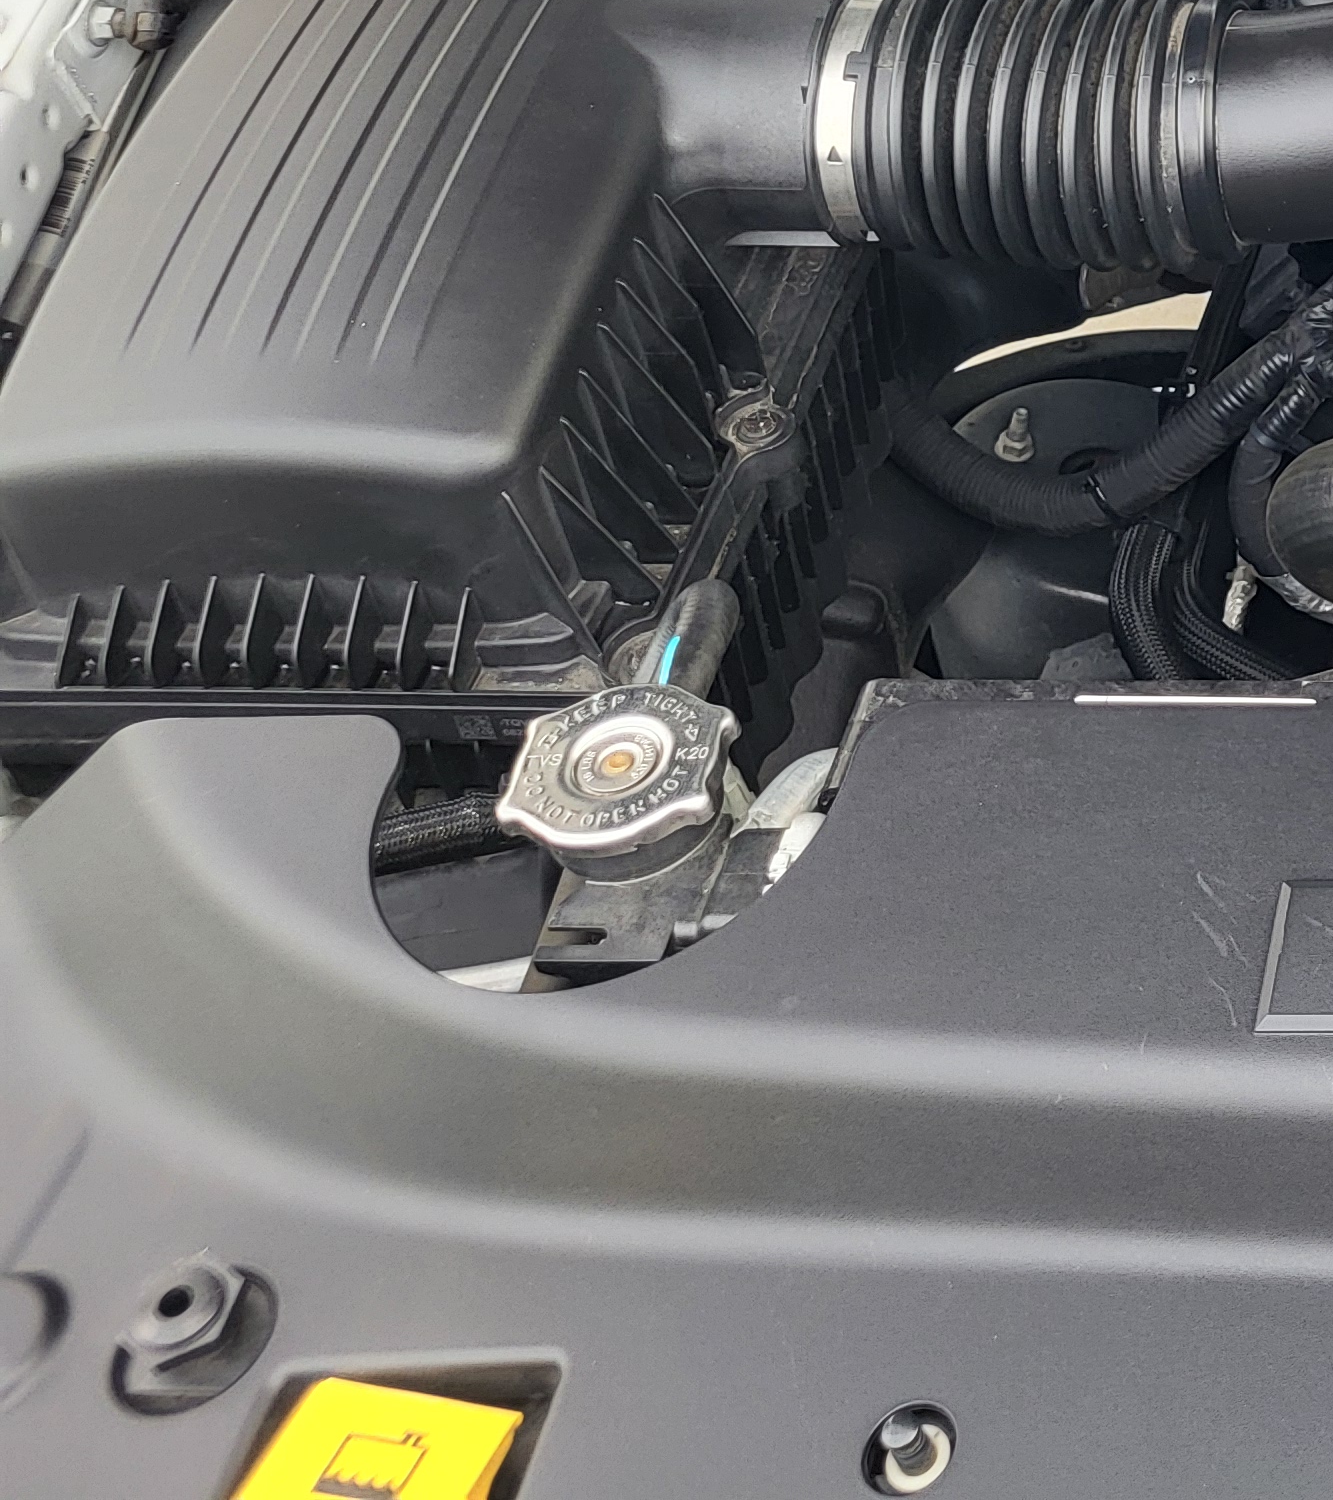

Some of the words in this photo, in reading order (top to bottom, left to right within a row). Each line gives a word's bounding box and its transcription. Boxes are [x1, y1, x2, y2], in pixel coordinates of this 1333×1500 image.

[561, 693, 627, 731] KEEP
[644, 691, 697, 723] TIGHT
[675, 746, 710, 761] K20
[535, 795, 579, 826] NOT
[580, 800, 647, 827] OPEN
[648, 766, 689, 805] HOT
